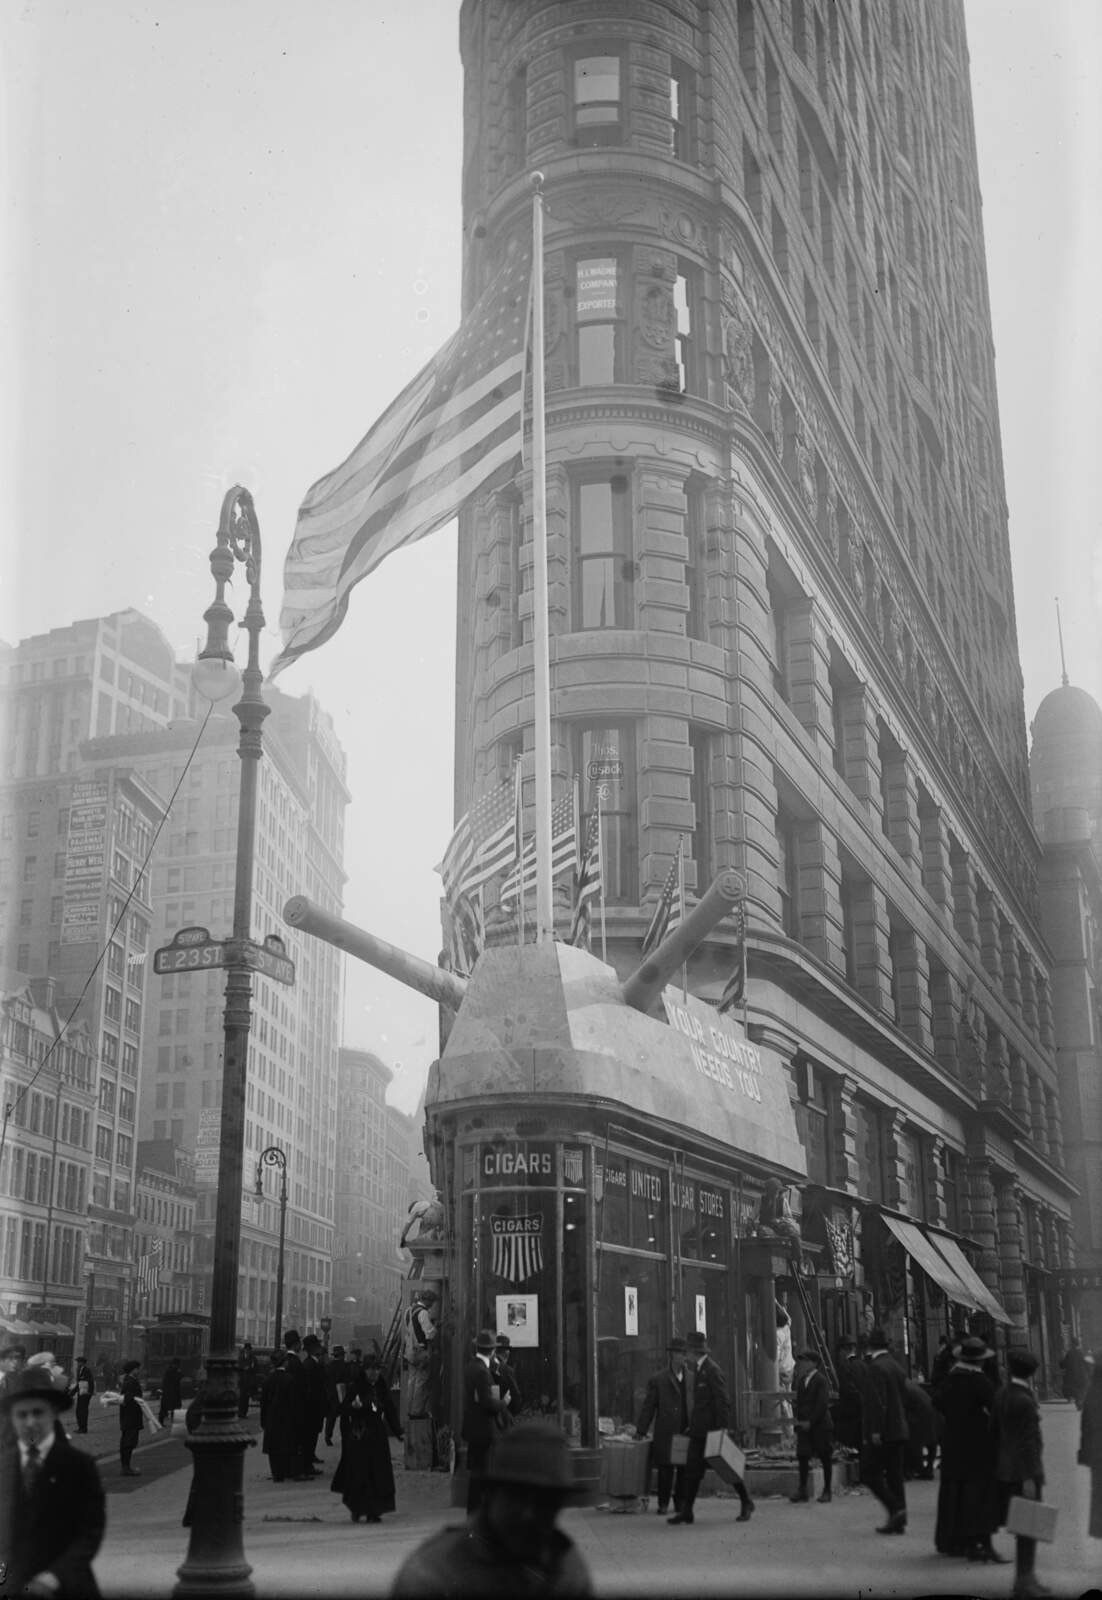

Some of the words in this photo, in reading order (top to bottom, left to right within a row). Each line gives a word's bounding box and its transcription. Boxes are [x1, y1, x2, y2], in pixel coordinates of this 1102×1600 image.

[588, 762, 623, 779] Cusack
[175, 948, 200, 968] 23
[666, 1002, 706, 1045] YOUR
[709, 1025, 763, 1076] COUNTRY
[690, 1043, 735, 1092] NEEDS
[734, 1067, 762, 1103] YOU
[484, 1152, 552, 1175] CIGARS
[605, 1168, 627, 1188] CIGARS
[631, 1169, 662, 1203] UNITED
[671, 1182, 695, 1211] CIGAR
[699, 1190, 724, 1219] STORES
[493, 1218, 540, 1233] CIGARS
